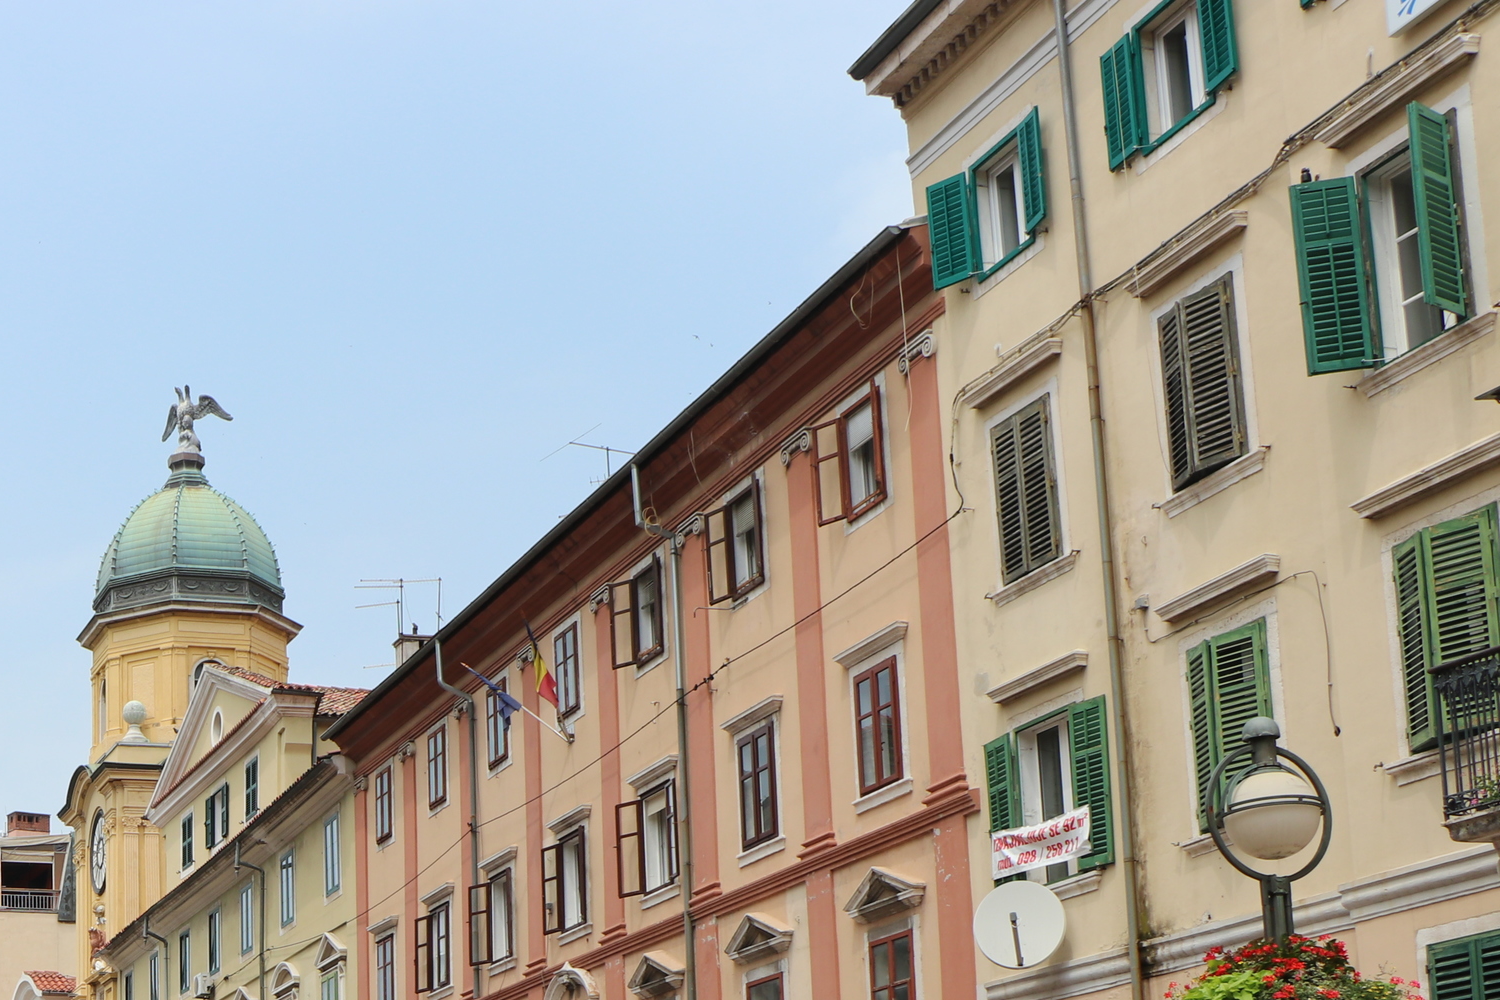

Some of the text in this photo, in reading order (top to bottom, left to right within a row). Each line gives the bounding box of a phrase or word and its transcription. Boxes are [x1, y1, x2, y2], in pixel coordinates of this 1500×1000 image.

[1049, 821, 1061, 838] SE
[1062, 816, 1077, 833] 92
[1016, 849, 1037, 866] 098
[1046, 842, 1063, 859] 258
